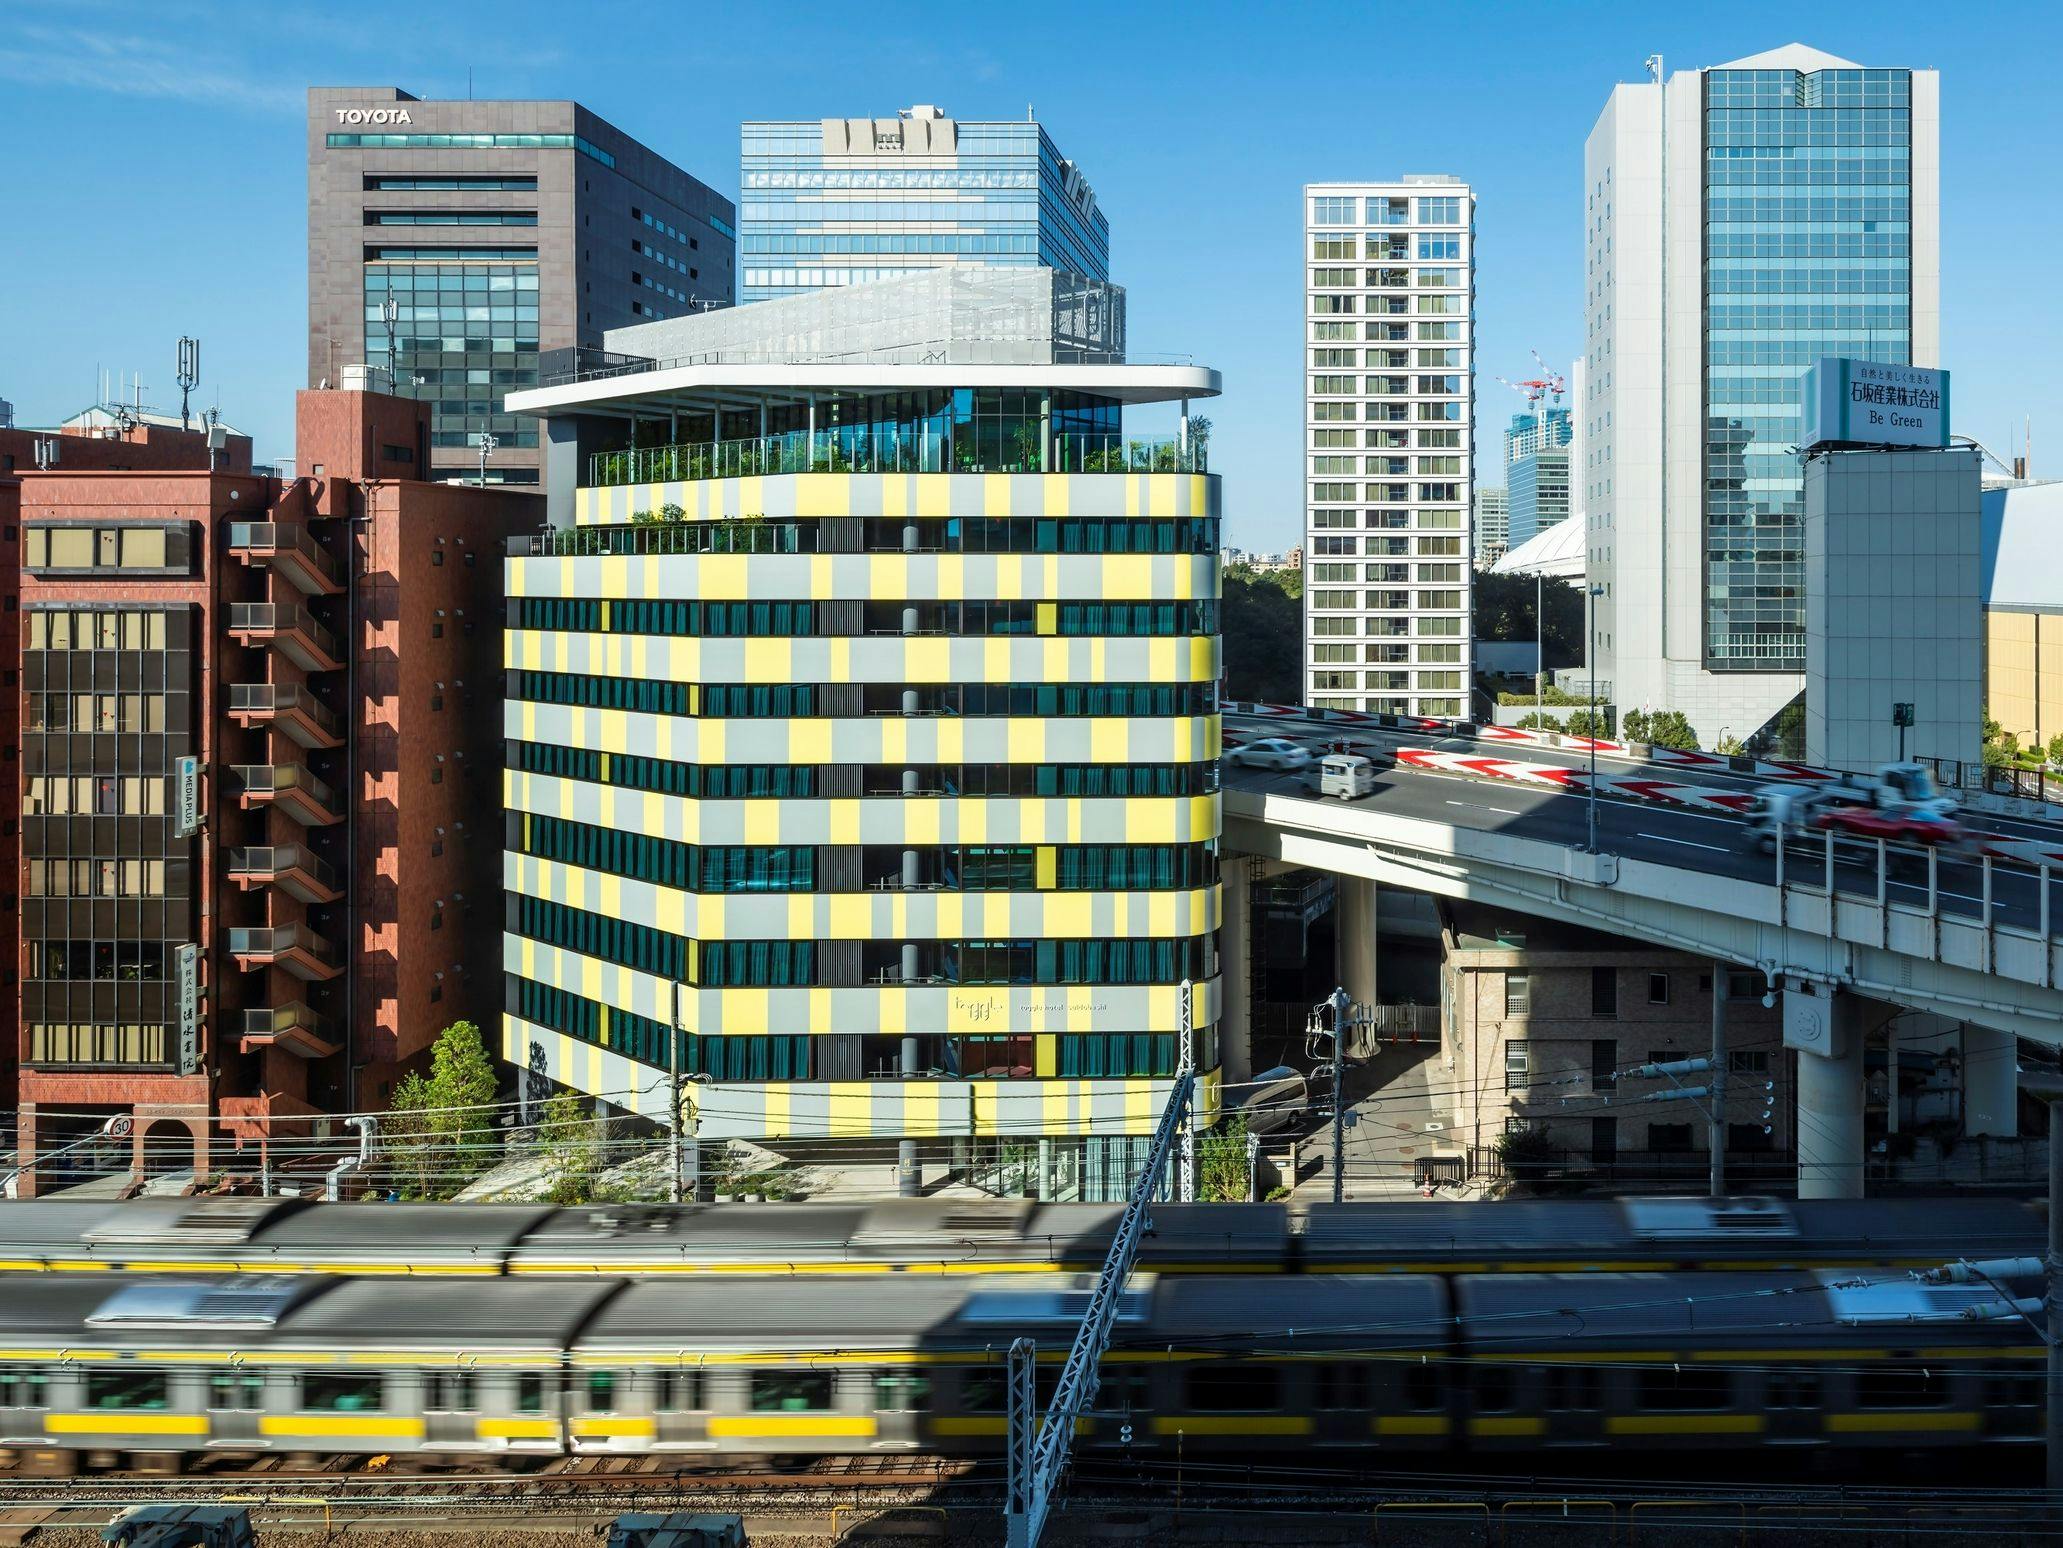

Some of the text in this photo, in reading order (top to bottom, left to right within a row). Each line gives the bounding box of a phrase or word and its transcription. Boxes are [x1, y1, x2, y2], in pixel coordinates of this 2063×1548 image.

[336, 109, 412, 124] TOYOTA
[1860, 367, 1930, 385] 自然と美しく生きる
[1850, 381, 1940, 410] 石坂産業株式会社
[1869, 410, 1923, 428] Be Green
[185, 775, 193, 824] MEDIAPLUS
[115, 1120, 129, 1135] 30
